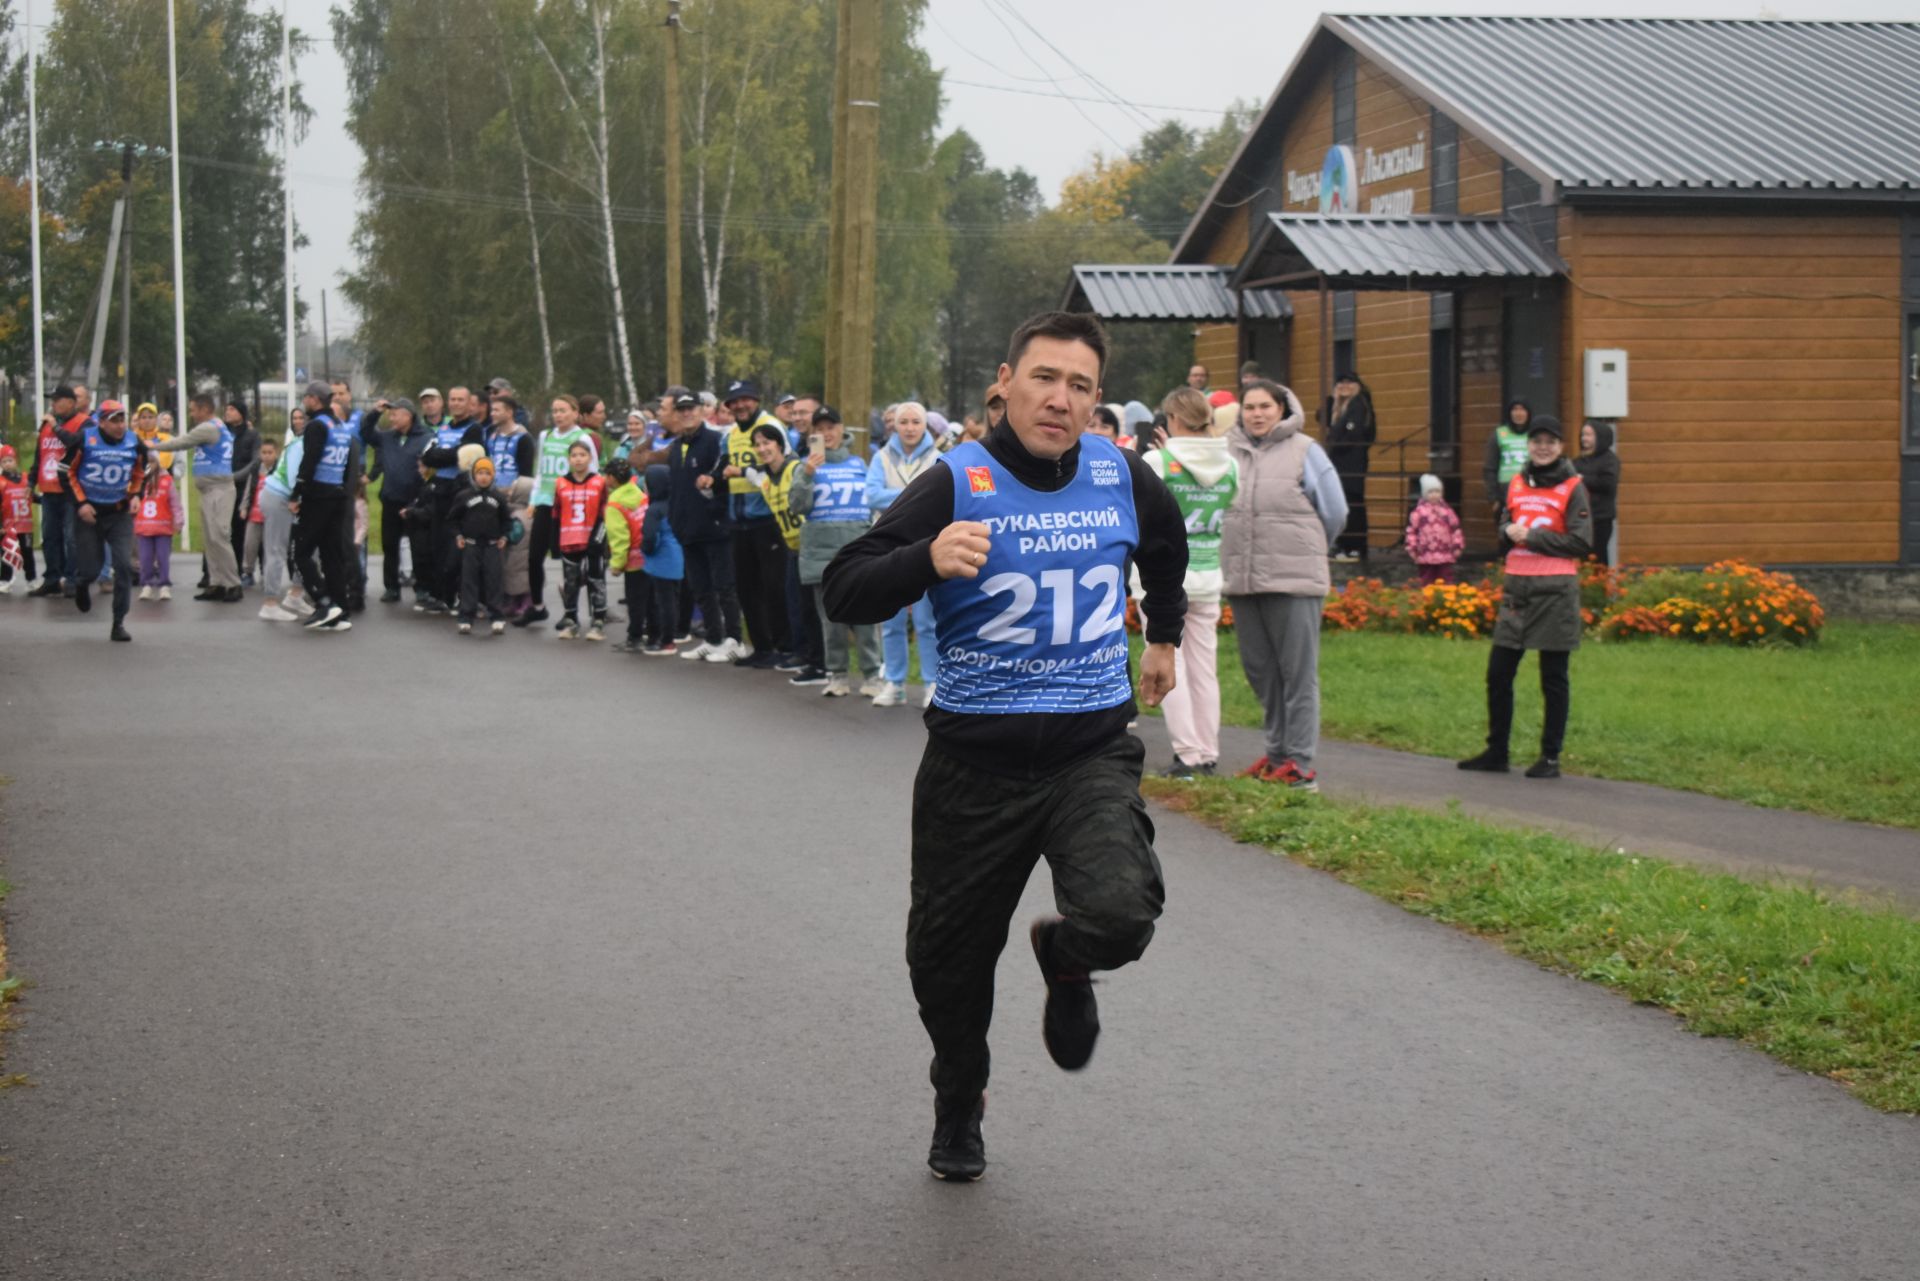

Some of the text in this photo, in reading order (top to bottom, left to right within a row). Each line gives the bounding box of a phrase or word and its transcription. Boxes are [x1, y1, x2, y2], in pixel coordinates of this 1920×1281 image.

[813, 482, 868, 507] 277
[143, 500, 158, 518] 8
[571, 503, 585, 524] 3
[981, 507, 1120, 535] ТУКАЕВСКИЙ
[1019, 531, 1097, 554] РАЙОН
[977, 564, 1122, 645] 212
